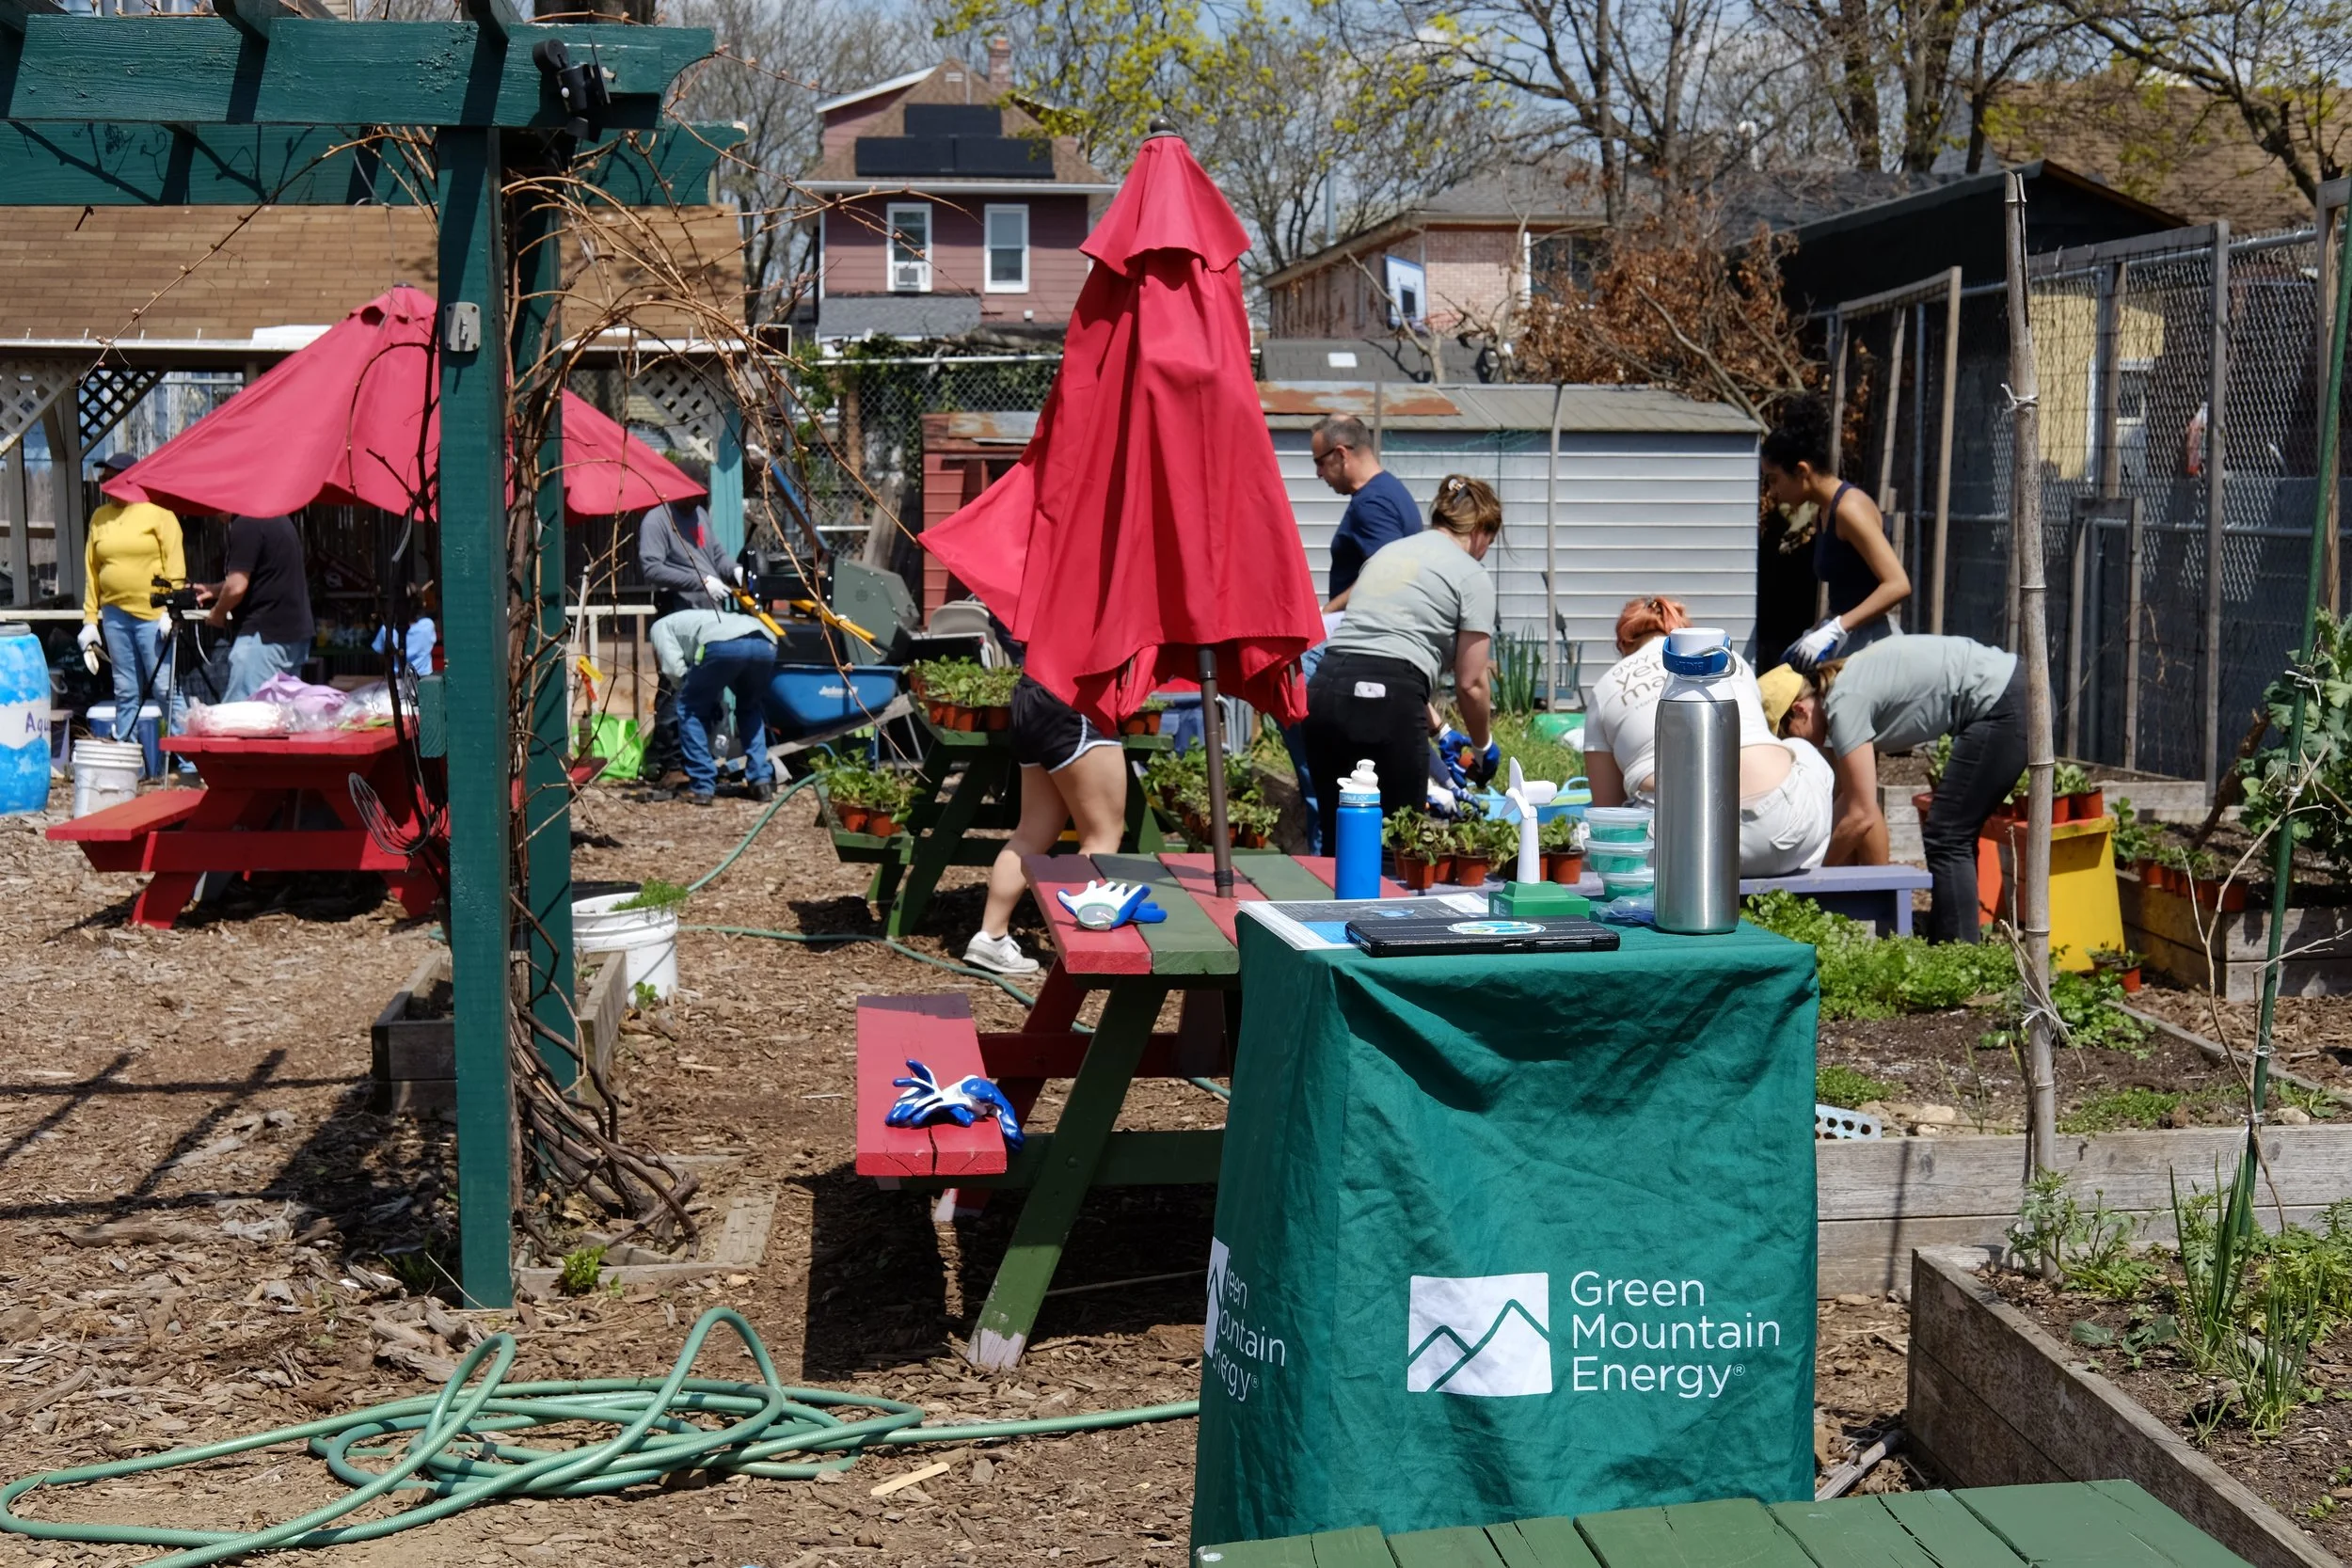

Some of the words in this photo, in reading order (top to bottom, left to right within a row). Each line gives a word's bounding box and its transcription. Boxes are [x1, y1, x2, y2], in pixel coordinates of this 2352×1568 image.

[1225, 1266, 1248, 1309] reen
[1570, 1271, 1705, 1307] Green
[1219, 1308, 1286, 1367] ountain
[1573, 1312, 1780, 1349] Mountain
